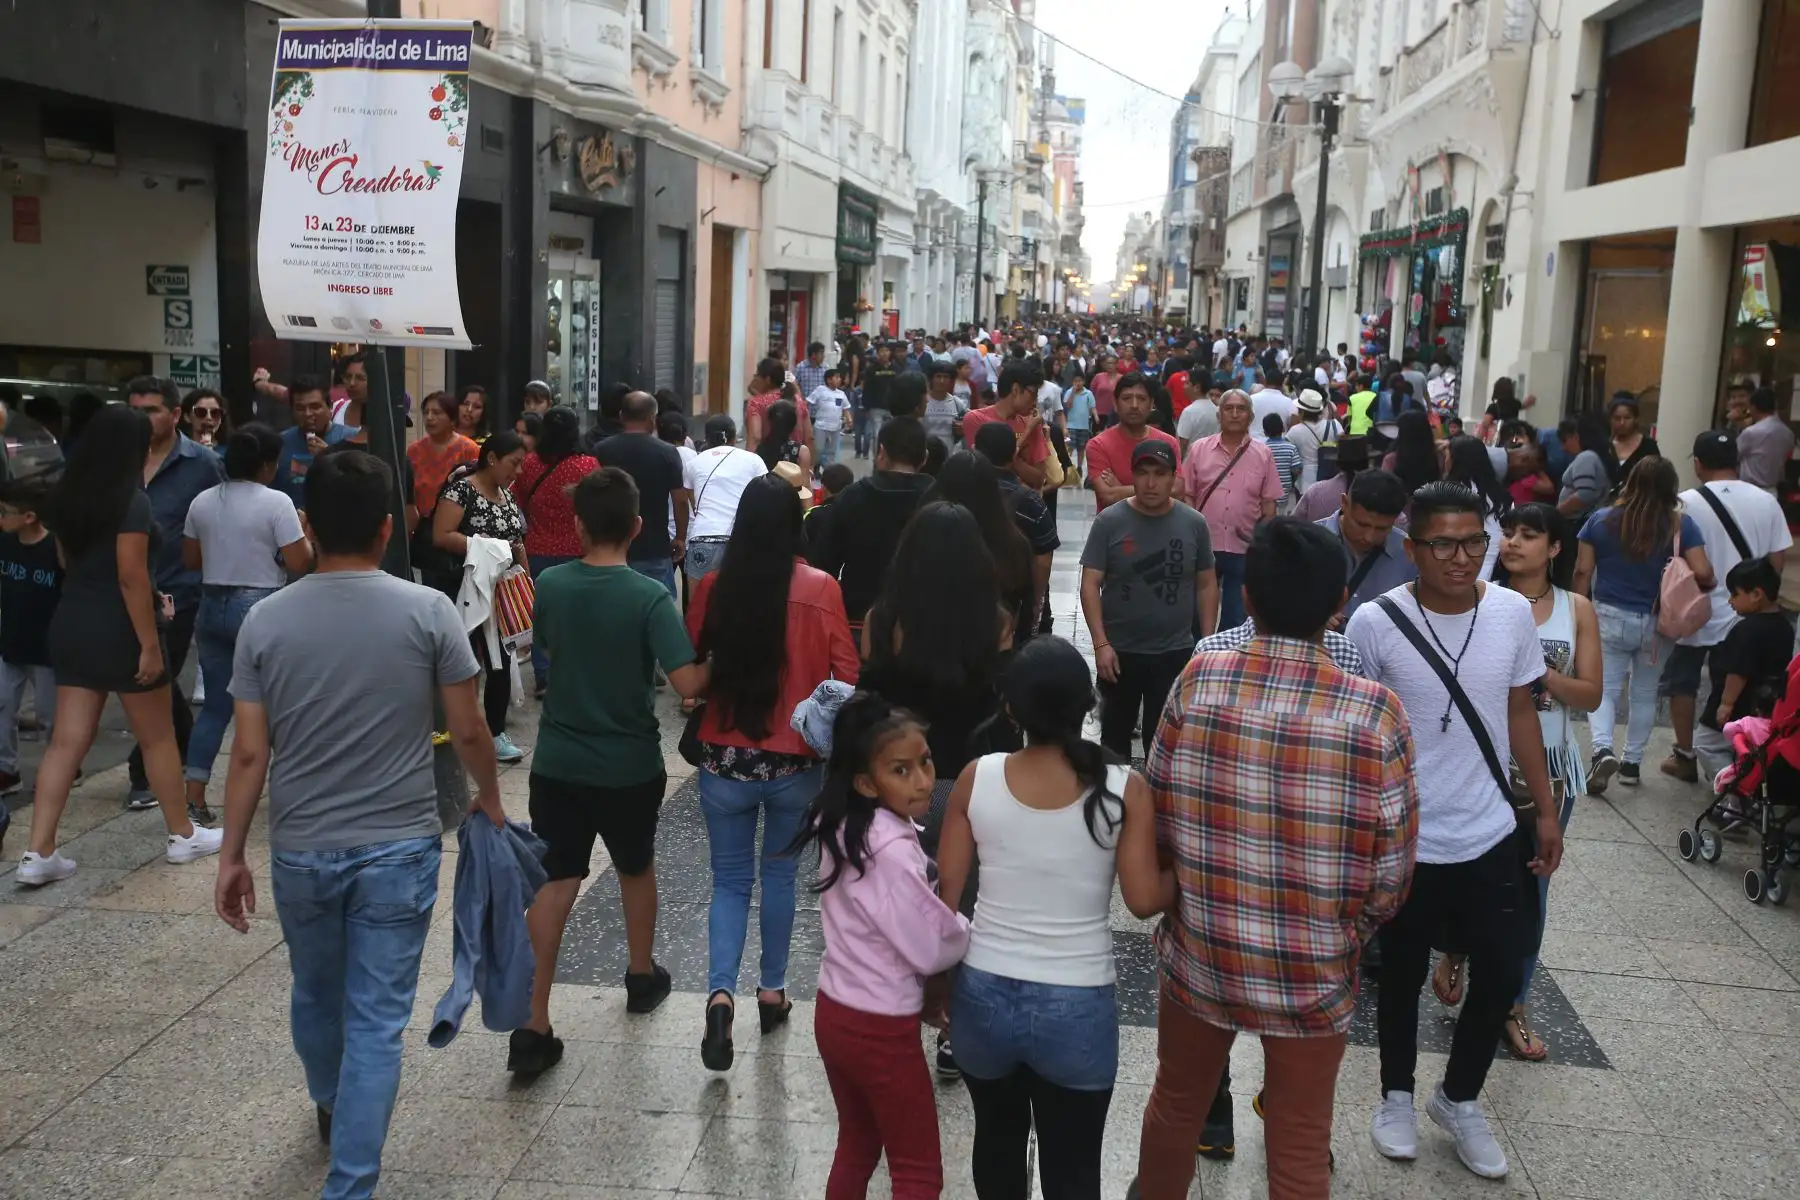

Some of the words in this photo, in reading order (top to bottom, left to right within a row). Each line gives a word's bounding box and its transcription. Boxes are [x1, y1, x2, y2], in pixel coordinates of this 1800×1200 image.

[282, 37, 396, 63] Municipalidad
[400, 39, 421, 60] de
[425, 40, 468, 62] Lima
[283, 138, 351, 183] Manos
[317, 153, 440, 195] Creadoras
[304, 215, 319, 230] 13
[321, 222, 334, 231] AL
[336, 216, 353, 232] 23
[354, 224, 367, 233] DE
[290, 242, 312, 250] Viernes
[320, 244, 348, 252] domingo
[327, 236, 348, 244] jueves
[356, 238, 375, 246] 10:00
[328, 283, 370, 295] INGRESO
[373, 286, 394, 296] LIBRE
[168, 301, 190, 328] S
[0, 560, 27, 580] LIMB
[1163, 538, 1184, 606] adidas
